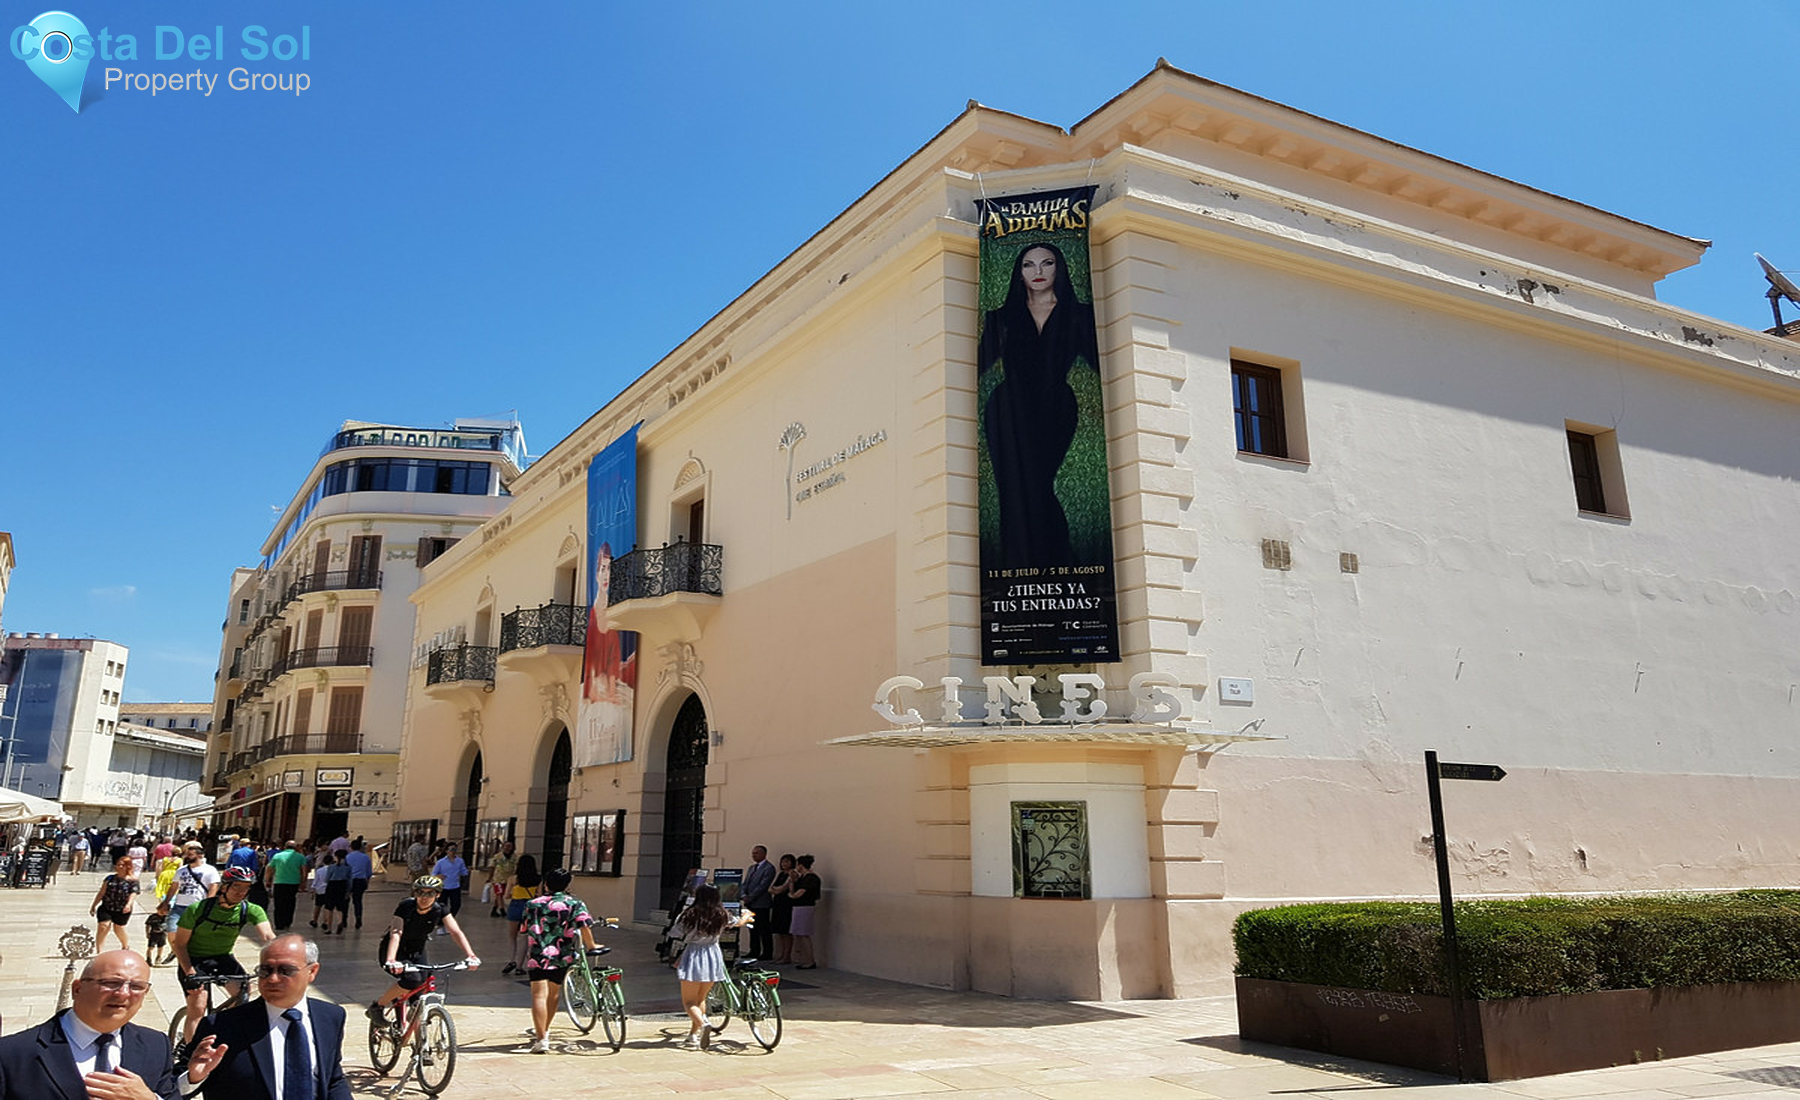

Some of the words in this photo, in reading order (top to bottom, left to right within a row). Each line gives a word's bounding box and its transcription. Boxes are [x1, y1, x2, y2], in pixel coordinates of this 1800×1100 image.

[984, 200, 1088, 238] ADDAMS
[988, 569, 999, 578] 11
[1001, 569, 1013, 578] DE
[1014, 567, 1039, 578] JULIO
[1049, 567, 1056, 576] 5
[1059, 566, 1070, 575] DE
[1072, 565, 1105, 575] AGOSTO
[1007, 583, 1063, 597] ¿TIENES
[1067, 582, 1086, 595] YA
[992, 600, 1018, 613] TUS
[1021, 597, 1101, 611] ENTRADAS?
[872, 673, 1182, 725] CINES
